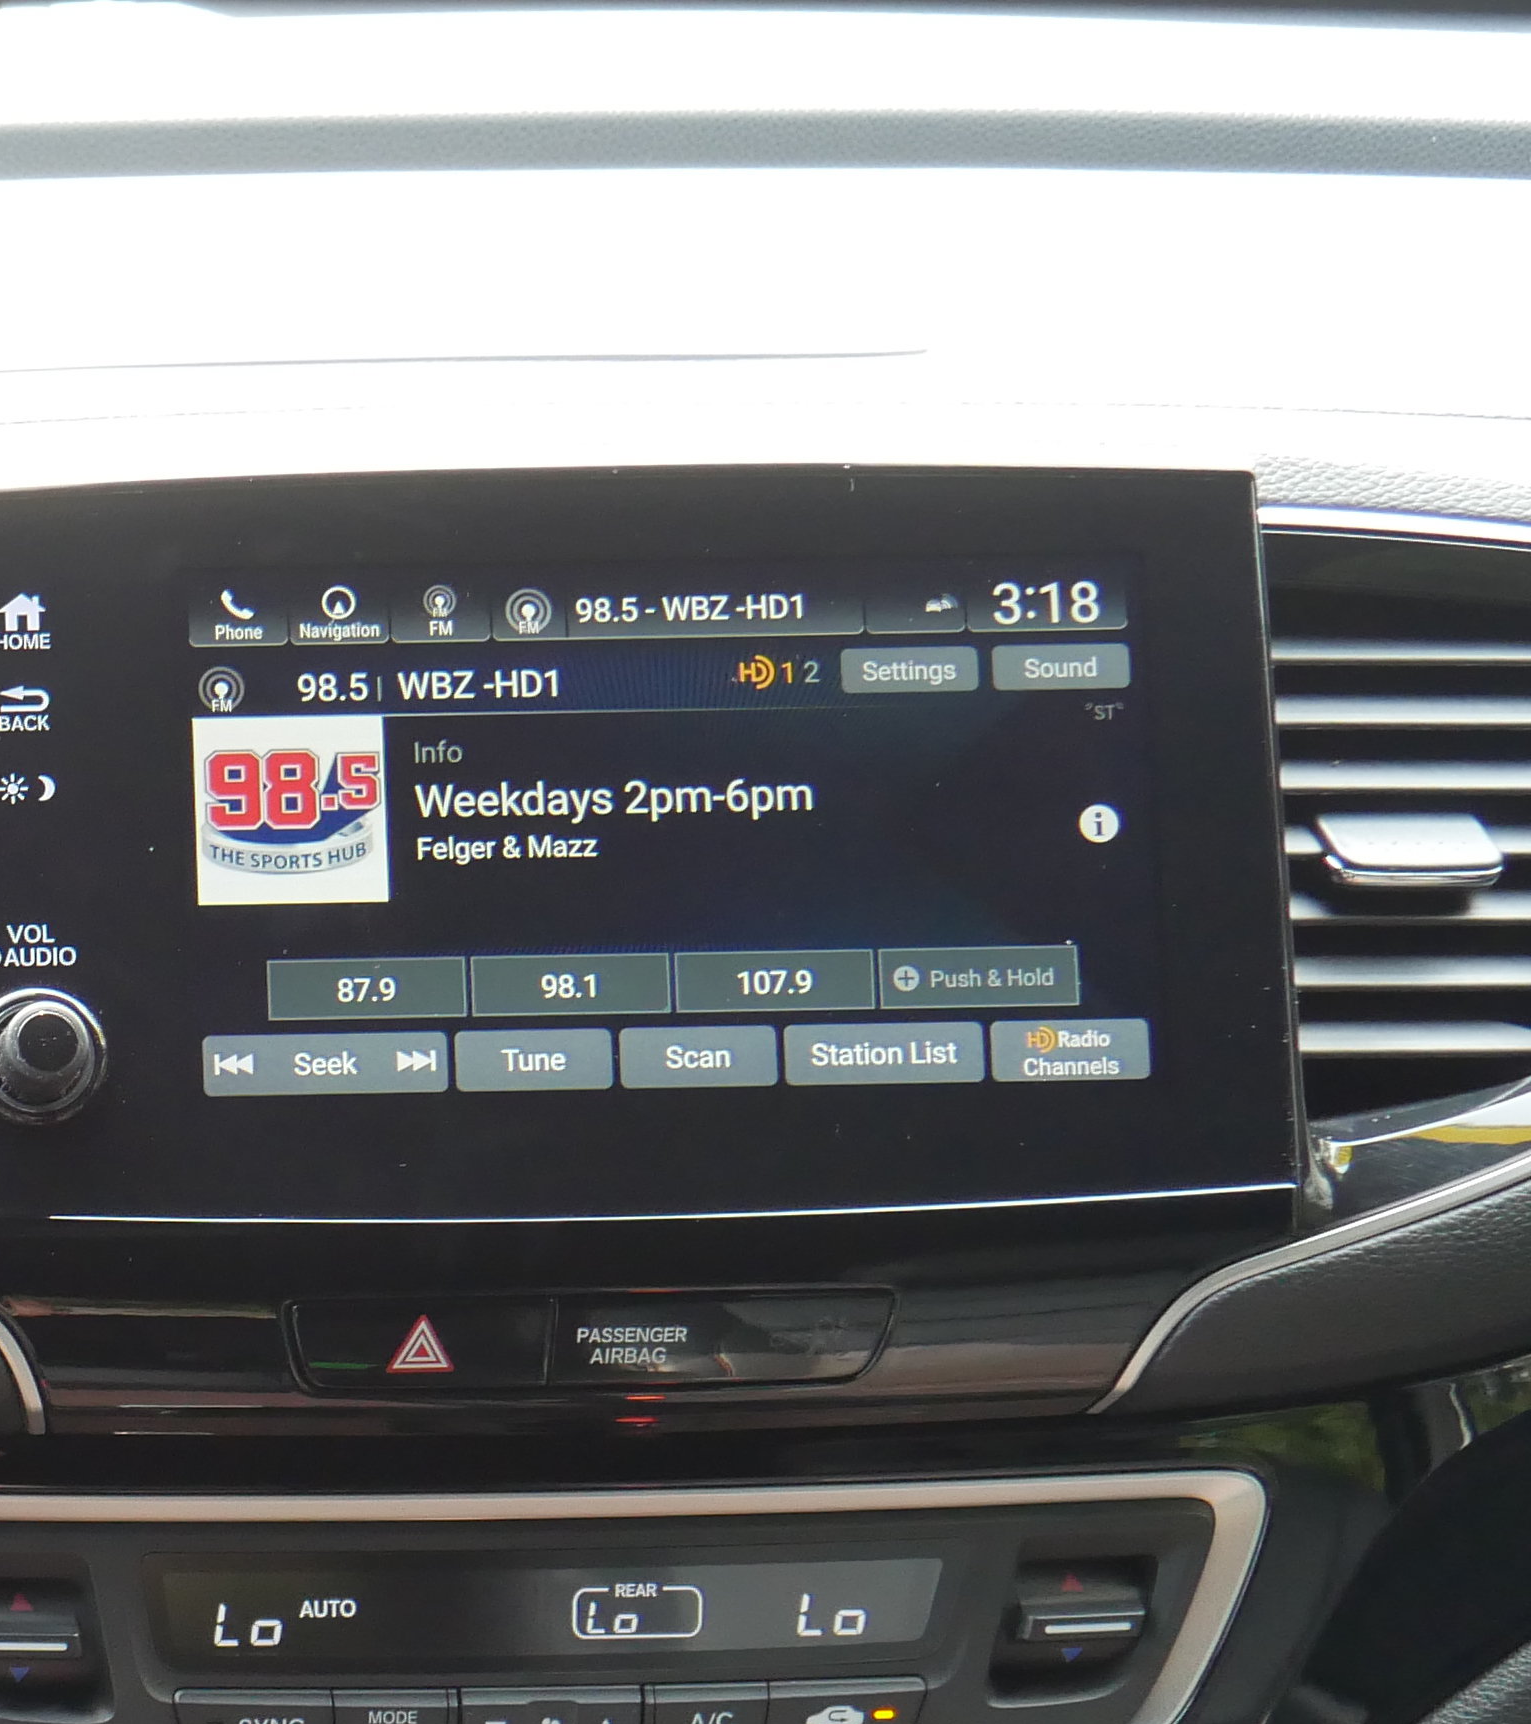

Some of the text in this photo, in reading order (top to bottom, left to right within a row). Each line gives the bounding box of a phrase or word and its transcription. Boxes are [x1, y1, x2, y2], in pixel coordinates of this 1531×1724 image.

[575, 598, 639, 622] 98.5
[662, 597, 729, 620] WBZ
[735, 595, 804, 619] -HD1
[992, 581, 1100, 625] 3:18
[215, 625, 263, 641] Phone
[299, 620, 380, 640] Navigation
[429, 621, 453, 636] FM
[518, 621, 539, 634] FM
[782, 662, 793, 684] 1
[804, 662, 820, 683] 2
[862, 660, 956, 682] Settings
[1024, 657, 1097, 678] Sound
[297, 670, 558, 702] 98.5 WBZ -HD1
[212, 700, 232, 712] FM
[414, 740, 463, 763] Info
[205, 749, 380, 830] 98.5
[415, 779, 813, 822] Weekdays 2pm-6pm
[210, 841, 367, 869] THE SPORTS HUB
[417, 836, 598, 863] Felger & Mazz
[7, 925, 55, 943] VOL
[4, 947, 77, 967] AUDIO
[541, 974, 599, 999] 98.1
[736, 970, 812, 995] 107.9
[930, 968, 1054, 989] Push & Hold
[337, 977, 396, 1003] 87.9
[1058, 1030, 1110, 1048] Radio
[294, 1052, 358, 1076] Seek
[501, 1048, 566, 1072] Tune
[666, 1046, 731, 1069] Scan
[811, 1042, 957, 1067] Station List
[1023, 1056, 1119, 1077] Channels
[577, 1327, 687, 1344] PASSENGER
[590, 1347, 667, 1365] AIRBAG
[615, 1583, 656, 1597] REAR
[300, 1600, 356, 1619] AUTO
[586, 1602, 638, 1635] Lo
[797, 1593, 866, 1637] Lo
[214, 1603, 283, 1648] Lo
[369, 1710, 417, 1724] MODE
